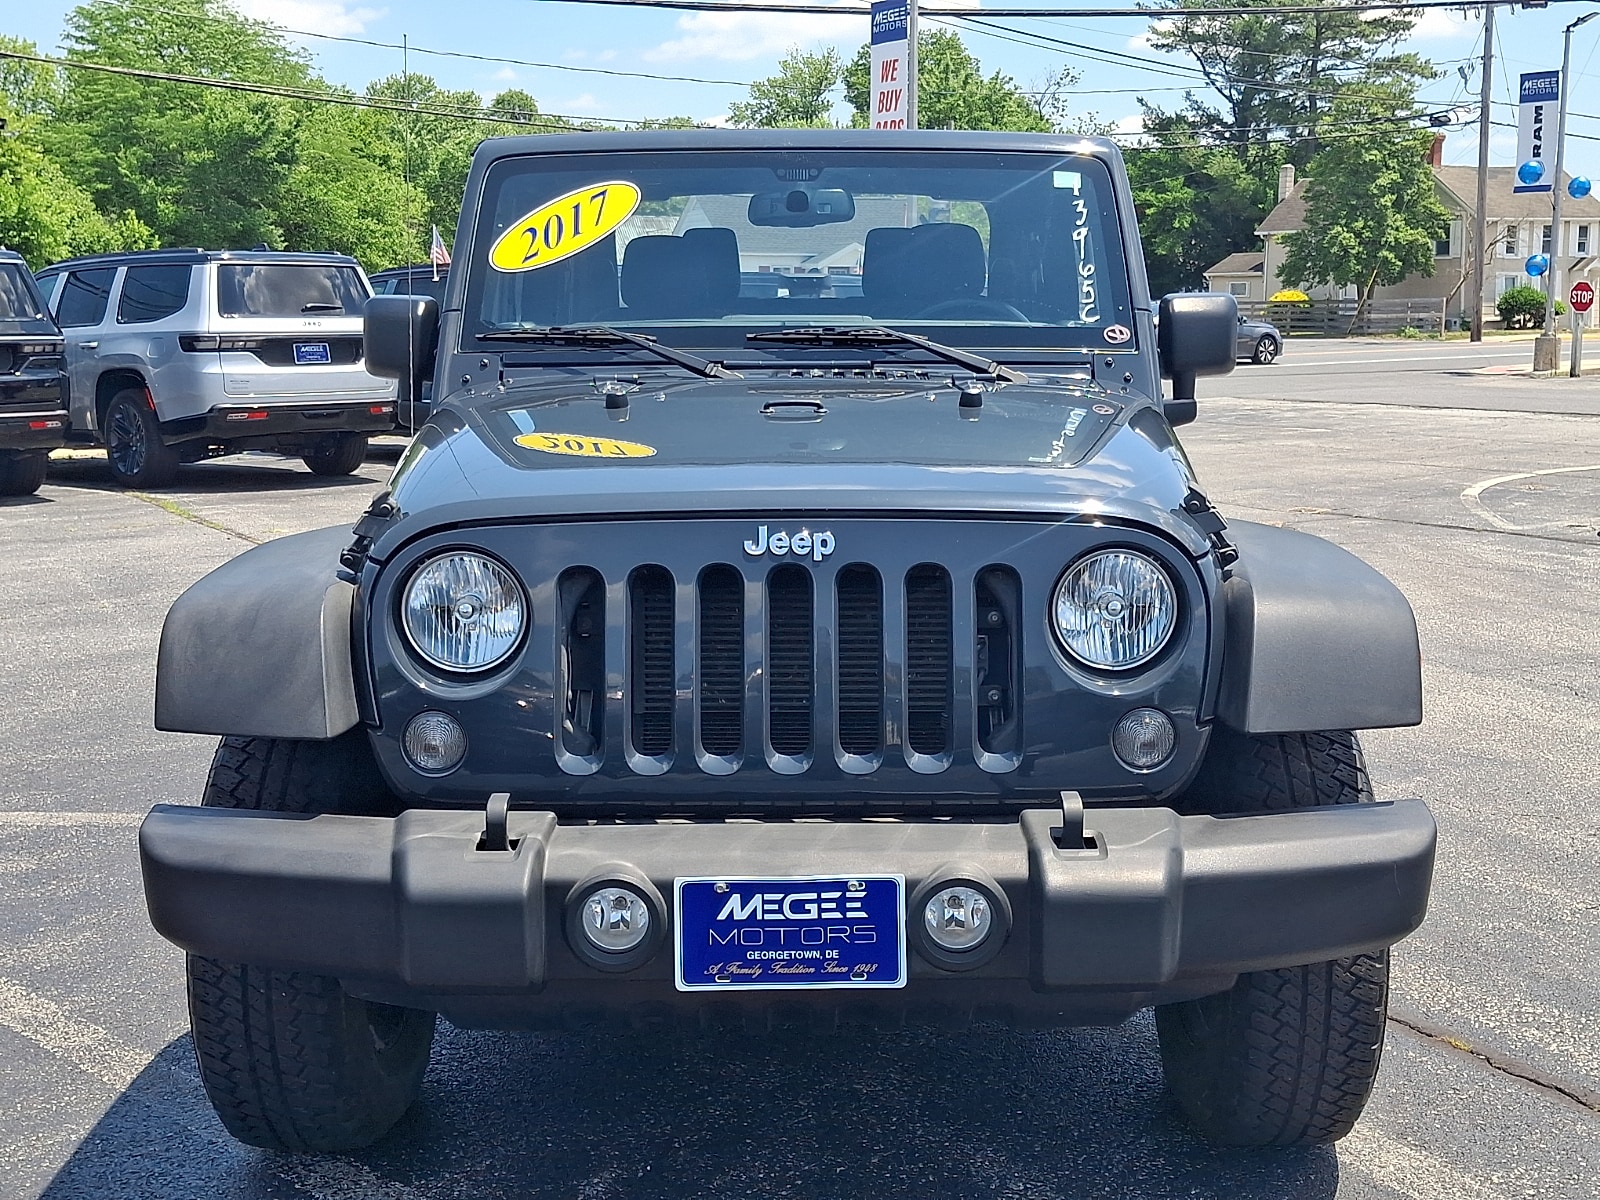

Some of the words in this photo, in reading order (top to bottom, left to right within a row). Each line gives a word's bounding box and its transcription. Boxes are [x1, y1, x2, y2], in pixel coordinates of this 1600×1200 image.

[873, 7, 906, 25] MEGEE
[873, 20, 907, 33] MOTORS
[881, 59, 899, 83] WE
[1521, 87, 1558, 96] MOTORS
[1522, 78, 1558, 89] MEGEE
[878, 89, 902, 113] BUY
[1532, 105, 1543, 158] RAM
[520, 189, 608, 264] 2017
[1571, 290, 1593, 303] STOP
[743, 524, 836, 561] Jeep
[716, 891, 868, 921] MEGEE
[709, 925, 876, 946] MOTORS
[746, 950, 823, 960] GEORGETOWN,
[825, 950, 839, 959] DE
[704, 963, 718, 975] A
[724, 961, 763, 979] Family
[768, 961, 816, 974] Tradition
[821, 961, 848, 973] Since
[853, 963, 878, 973] 1948
